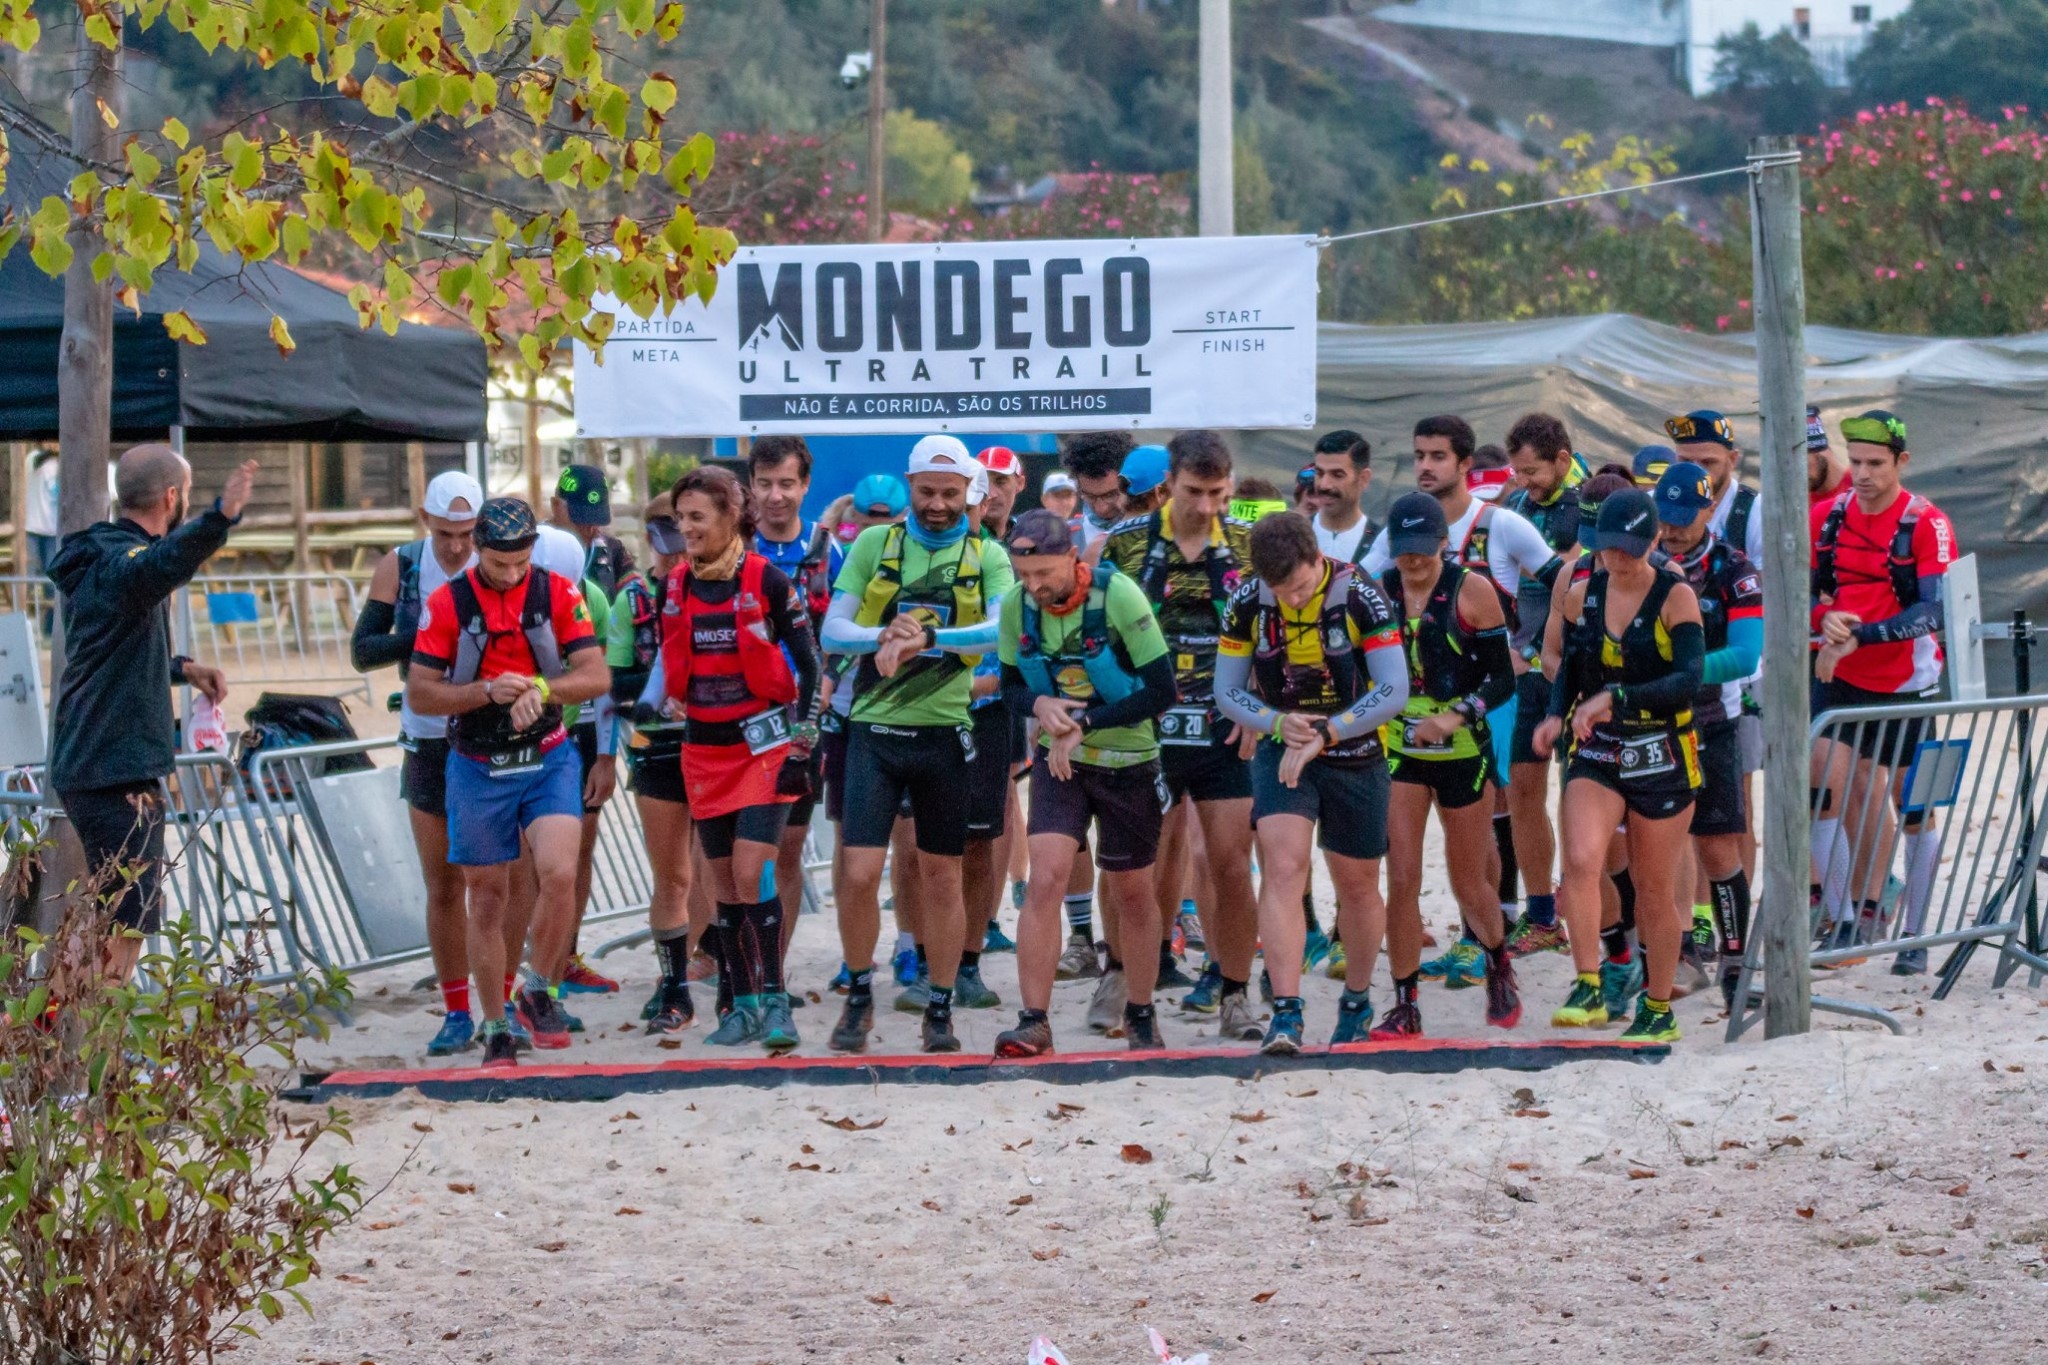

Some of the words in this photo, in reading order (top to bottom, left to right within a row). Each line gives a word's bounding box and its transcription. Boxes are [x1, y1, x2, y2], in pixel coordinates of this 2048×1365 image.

[737, 257, 1151, 352] MONDEGO
[617, 320, 695, 334] PARTIDA
[1206, 310, 1261, 324] START
[633, 350, 680, 362] META
[1203, 339, 1264, 353] FINISH
[739, 358, 931, 383] ULTRA
[969, 354, 1151, 380] TRAIL
[784, 397, 821, 414] NÃO
[829, 396, 839, 413] É
[846, 400, 857, 413] A
[864, 398, 950, 414] CORRIDA,
[958, 396, 992, 412] SÃO
[1000, 397, 1022, 411] OS
[1029, 395, 1107, 410] TRILHOS
[1929, 517, 1951, 564] BERG
[1353, 683, 1394, 719] SKINS
[768, 713, 787, 737] 12
[1185, 714, 1203, 735] 20
[1646, 741, 1663, 764] 35
